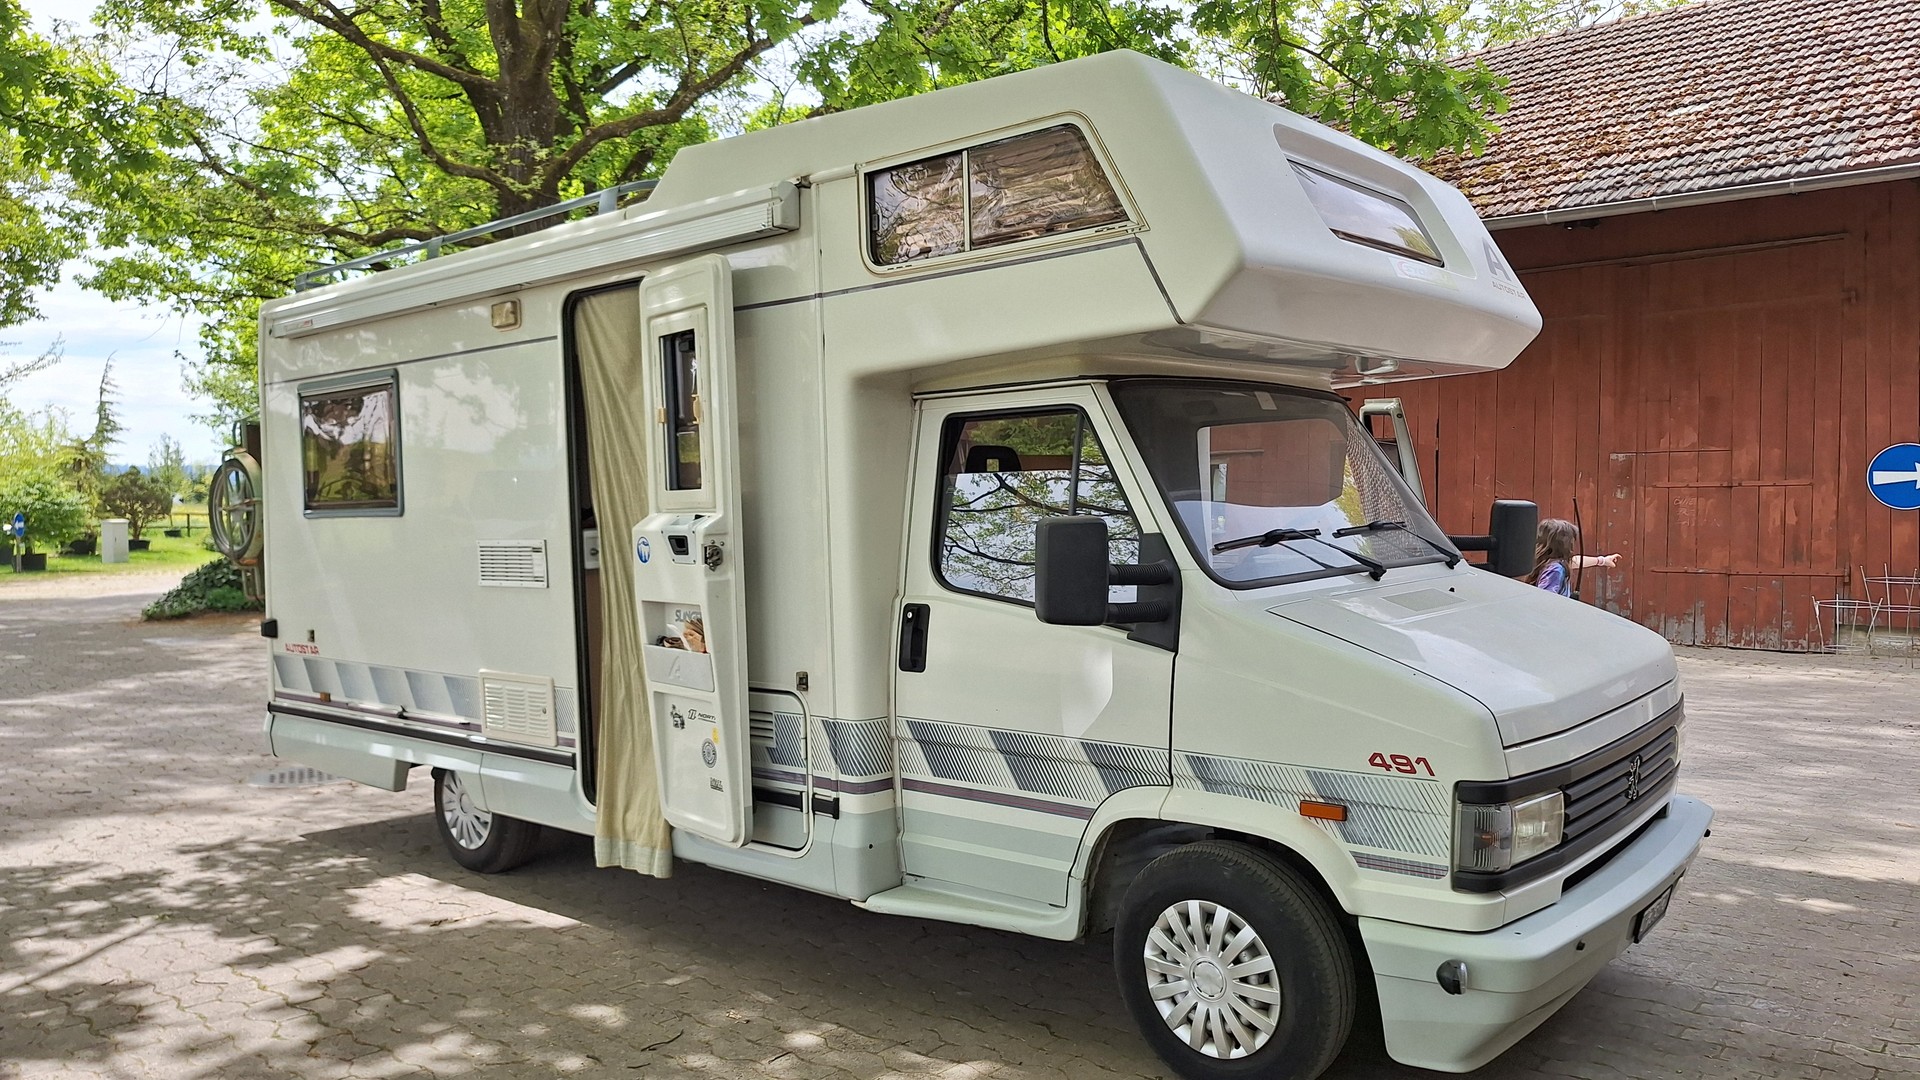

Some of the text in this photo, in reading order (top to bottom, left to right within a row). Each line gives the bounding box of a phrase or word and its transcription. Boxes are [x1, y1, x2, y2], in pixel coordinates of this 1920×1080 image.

[1492, 281, 1526, 300] AUTOSTAR
[285, 643, 319, 655] AUTOSTAR
[1368, 752, 1435, 776] 491
